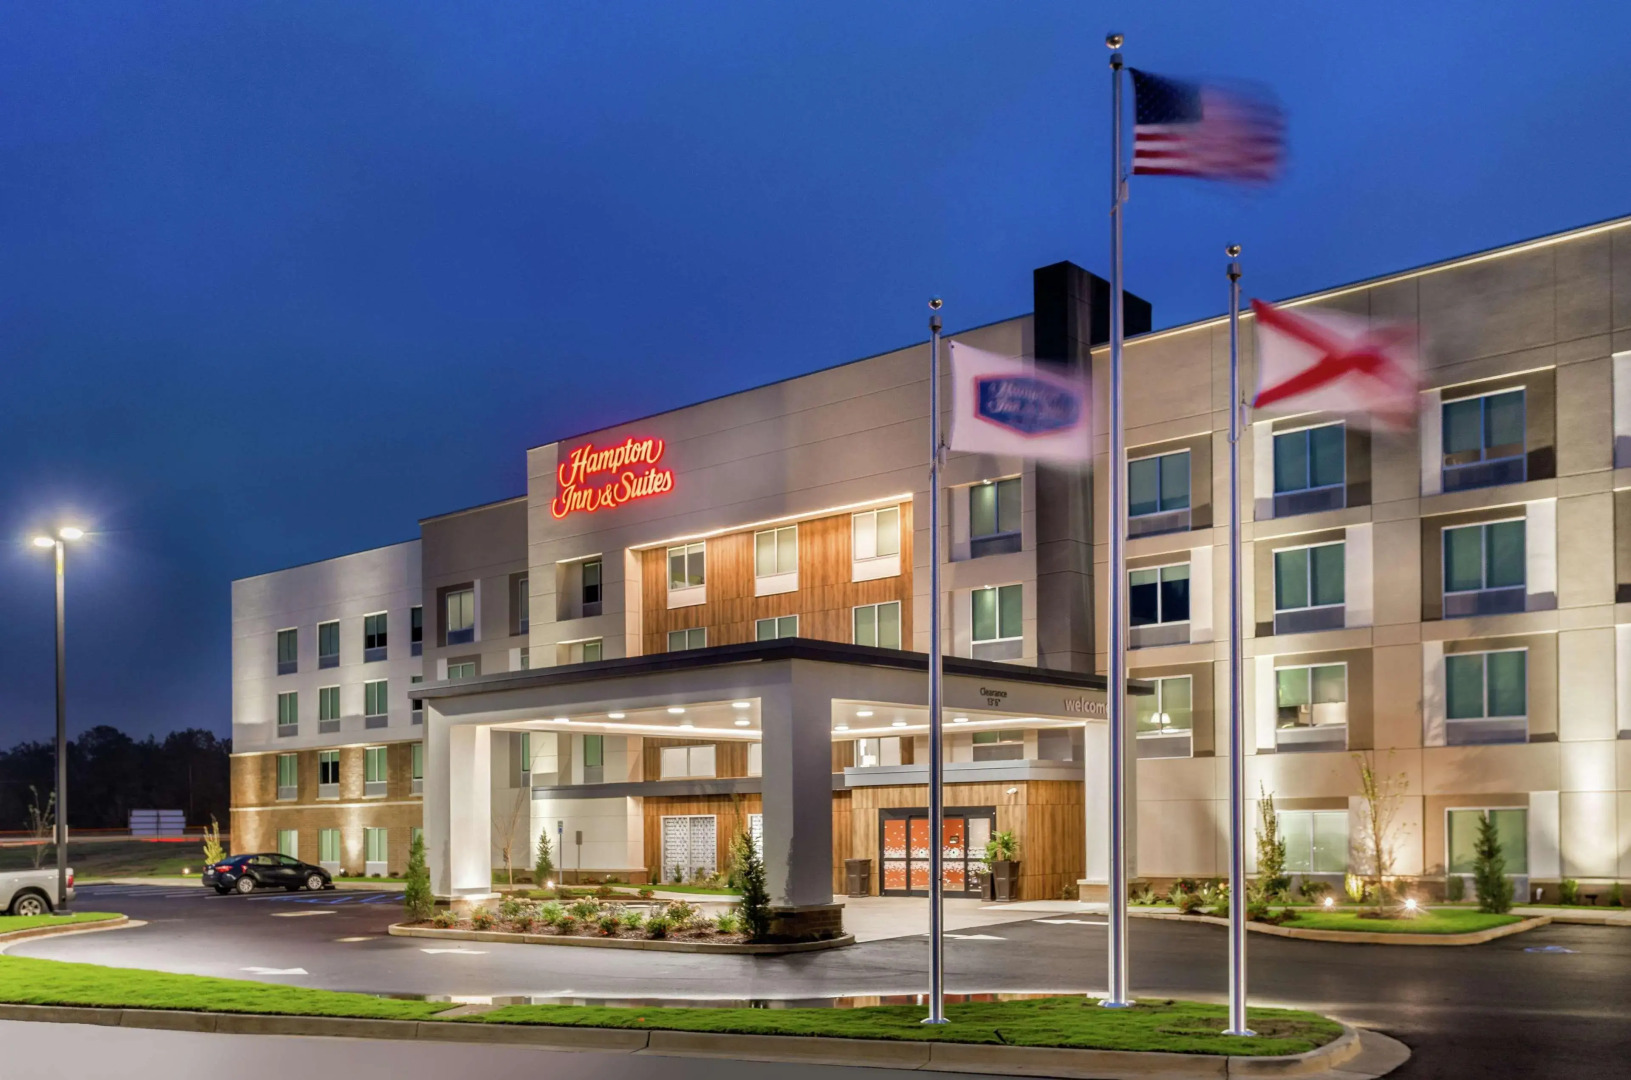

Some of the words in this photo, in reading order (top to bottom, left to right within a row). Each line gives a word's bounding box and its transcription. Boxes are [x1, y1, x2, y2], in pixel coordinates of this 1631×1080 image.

[559, 438, 664, 487] Hampton
[552, 484, 602, 518] Inn
[601, 483, 616, 507] &
[613, 468, 673, 502] Suites
[979, 687, 1008, 698] Clearance
